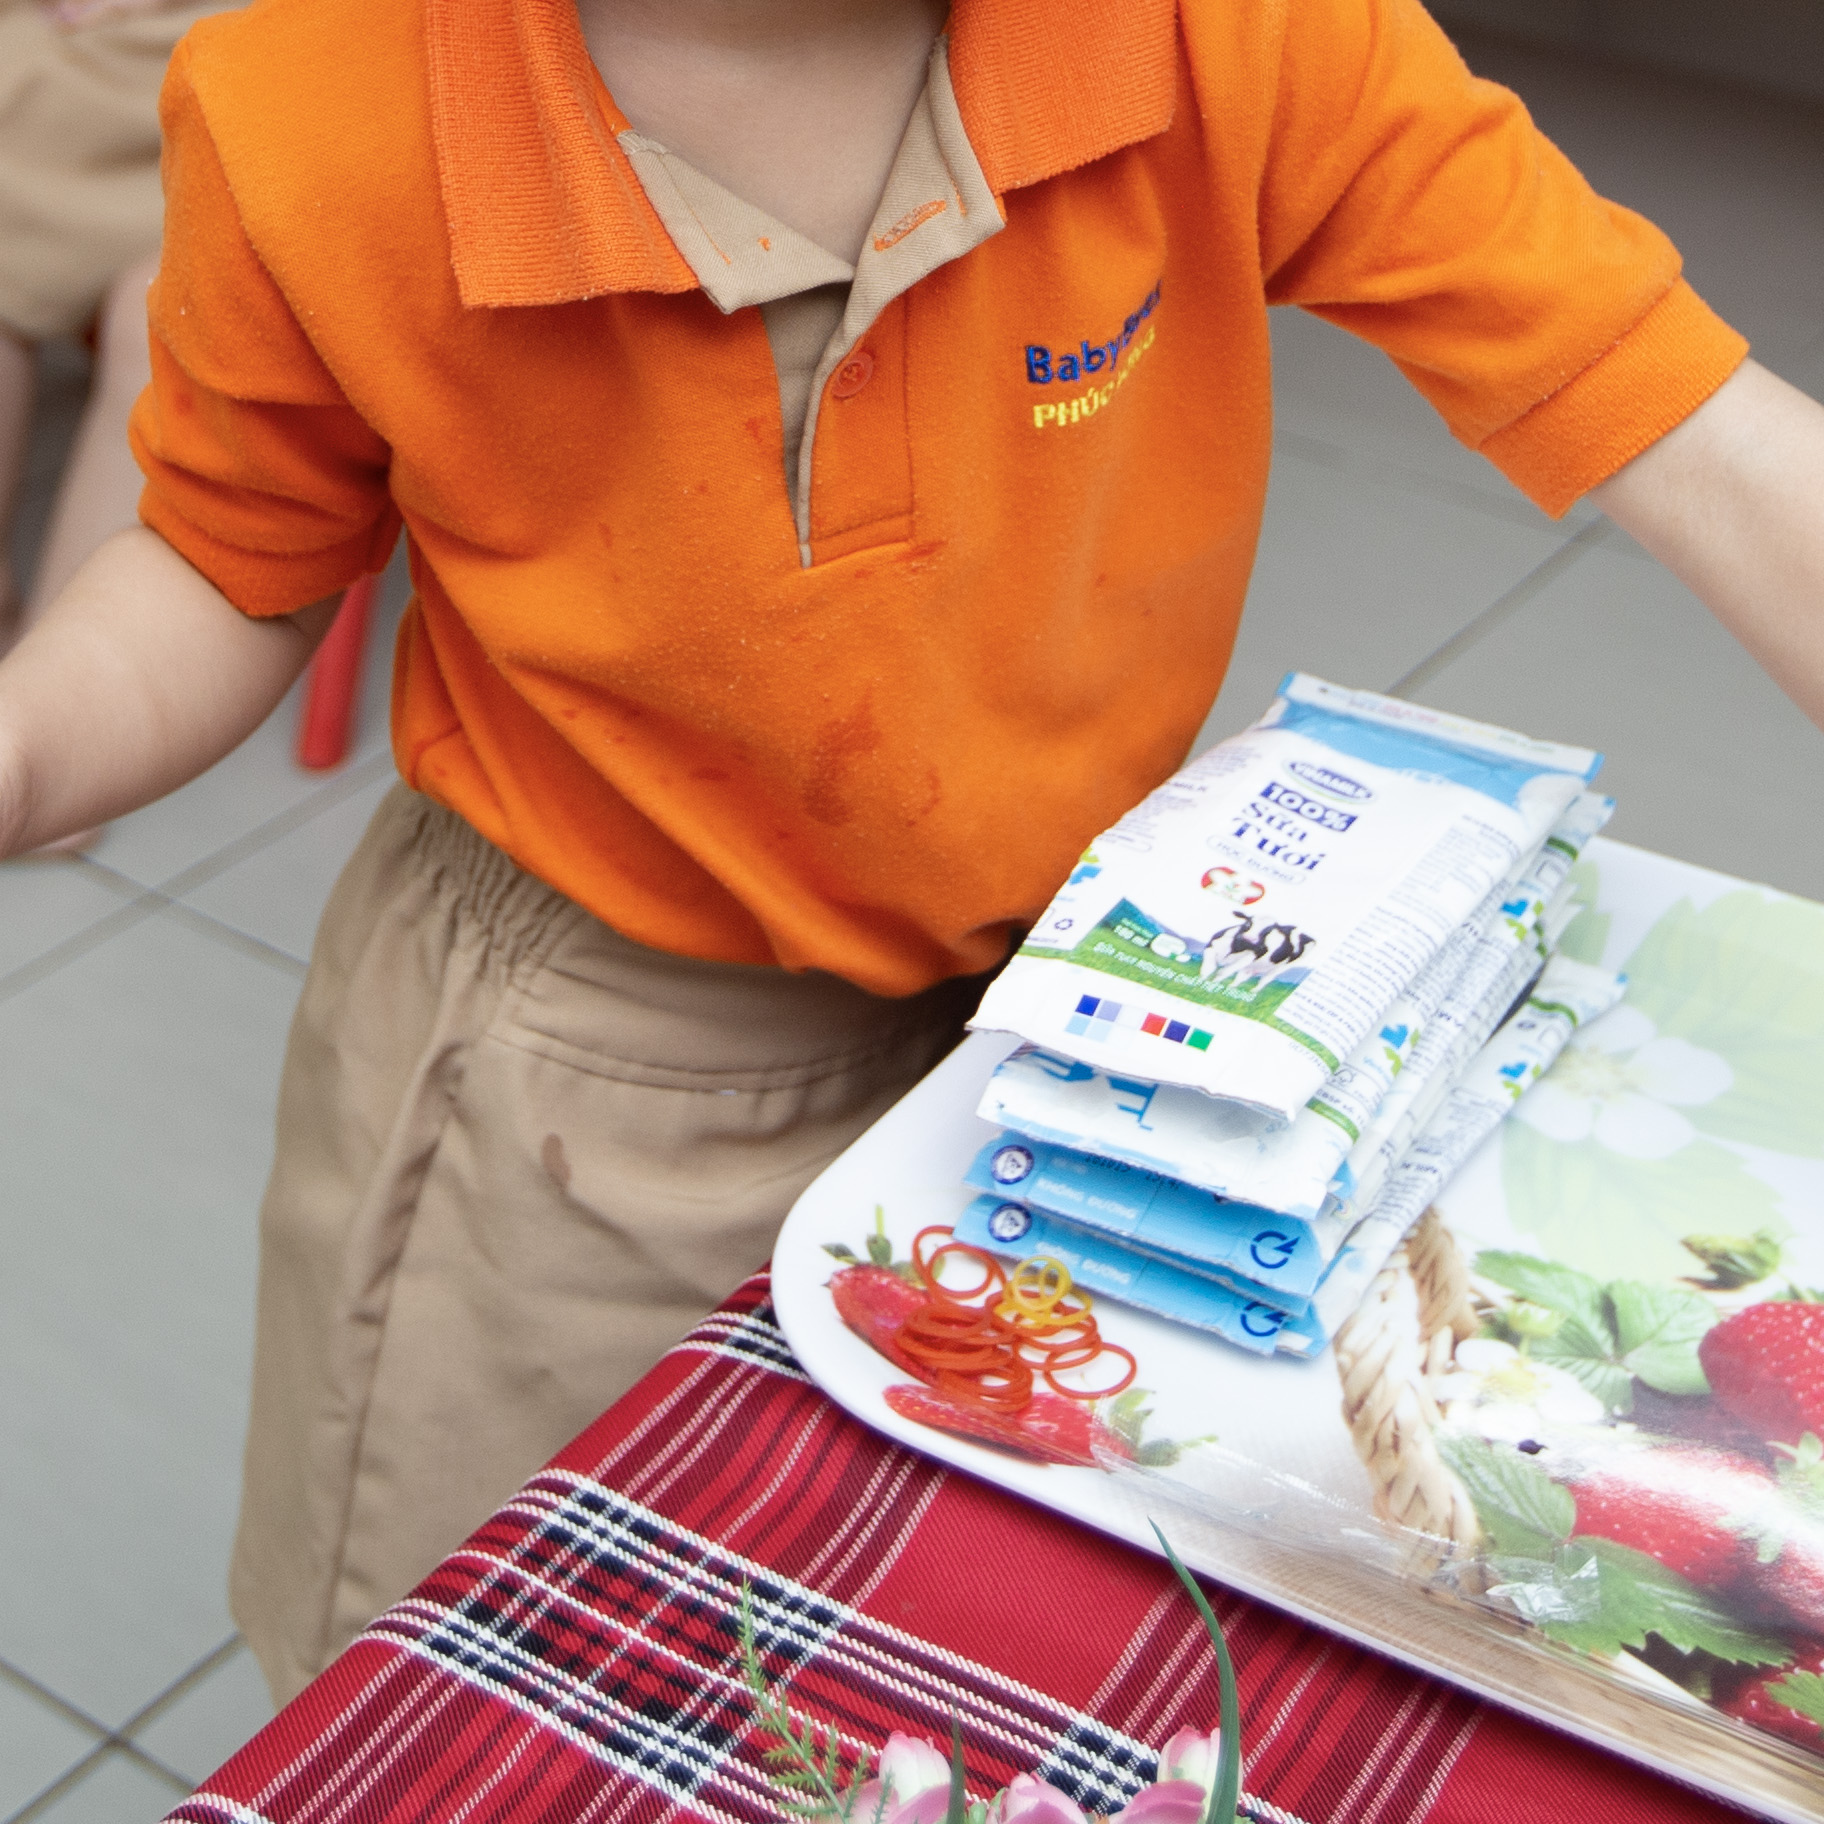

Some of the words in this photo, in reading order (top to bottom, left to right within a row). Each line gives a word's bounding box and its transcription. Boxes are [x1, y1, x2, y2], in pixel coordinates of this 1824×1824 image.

[1289, 761, 1372, 799] VINAMILK
[1242, 800, 1309, 843] Sữa
[1266, 782, 1354, 833] 100%
[1231, 816, 1327, 871] Tươi
